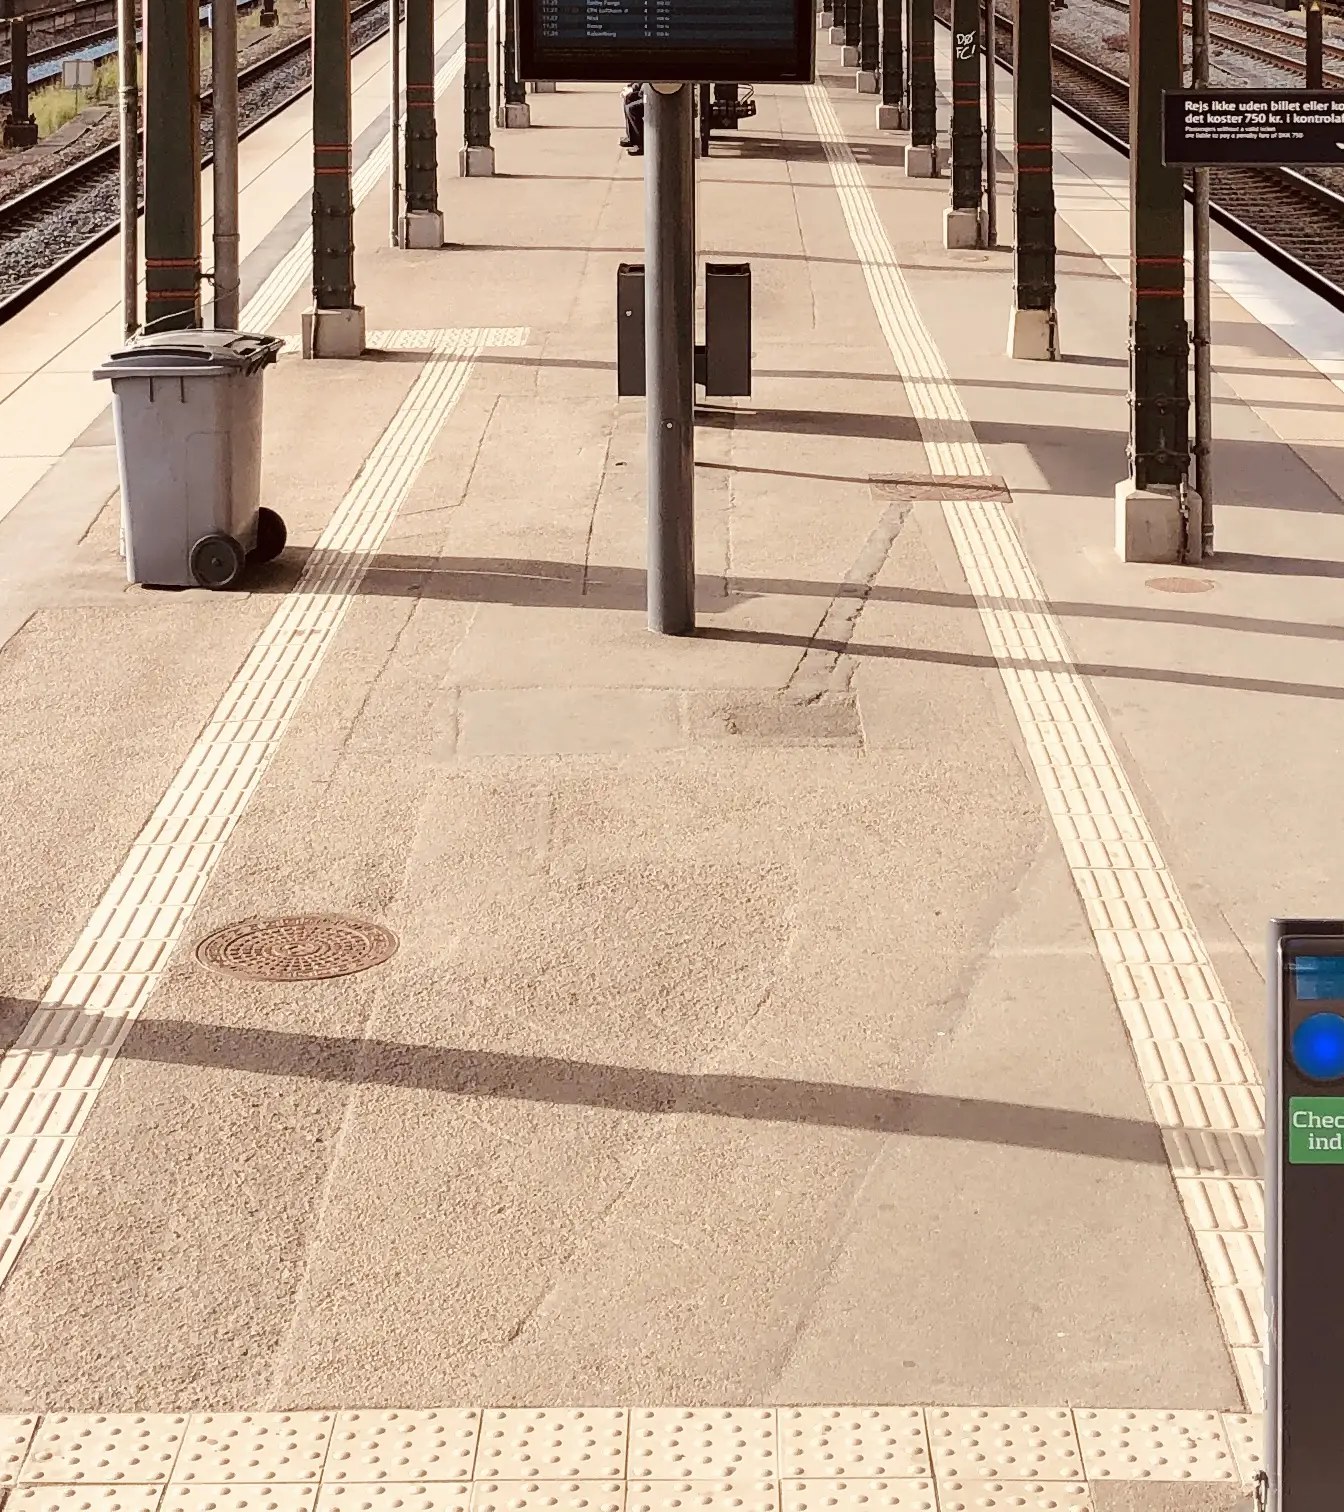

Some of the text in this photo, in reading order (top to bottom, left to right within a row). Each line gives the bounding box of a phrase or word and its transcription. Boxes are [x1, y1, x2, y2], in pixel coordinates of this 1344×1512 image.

[956, 30, 976, 46] DØ
[955, 45, 976, 60] FC!
[1184, 101, 1209, 113] Rejs
[1211, 101, 1236, 111] ikke
[1239, 101, 1268, 111] uden
[1270, 101, 1300, 111] billet
[1303, 101, 1329, 111] eller
[1185, 113, 1204, 124] det
[1207, 113, 1244, 124] koster
[1244, 113, 1266, 124] 750
[1268, 113, 1284, 124] kr.
[1307, 1132, 1343, 1150] ind
